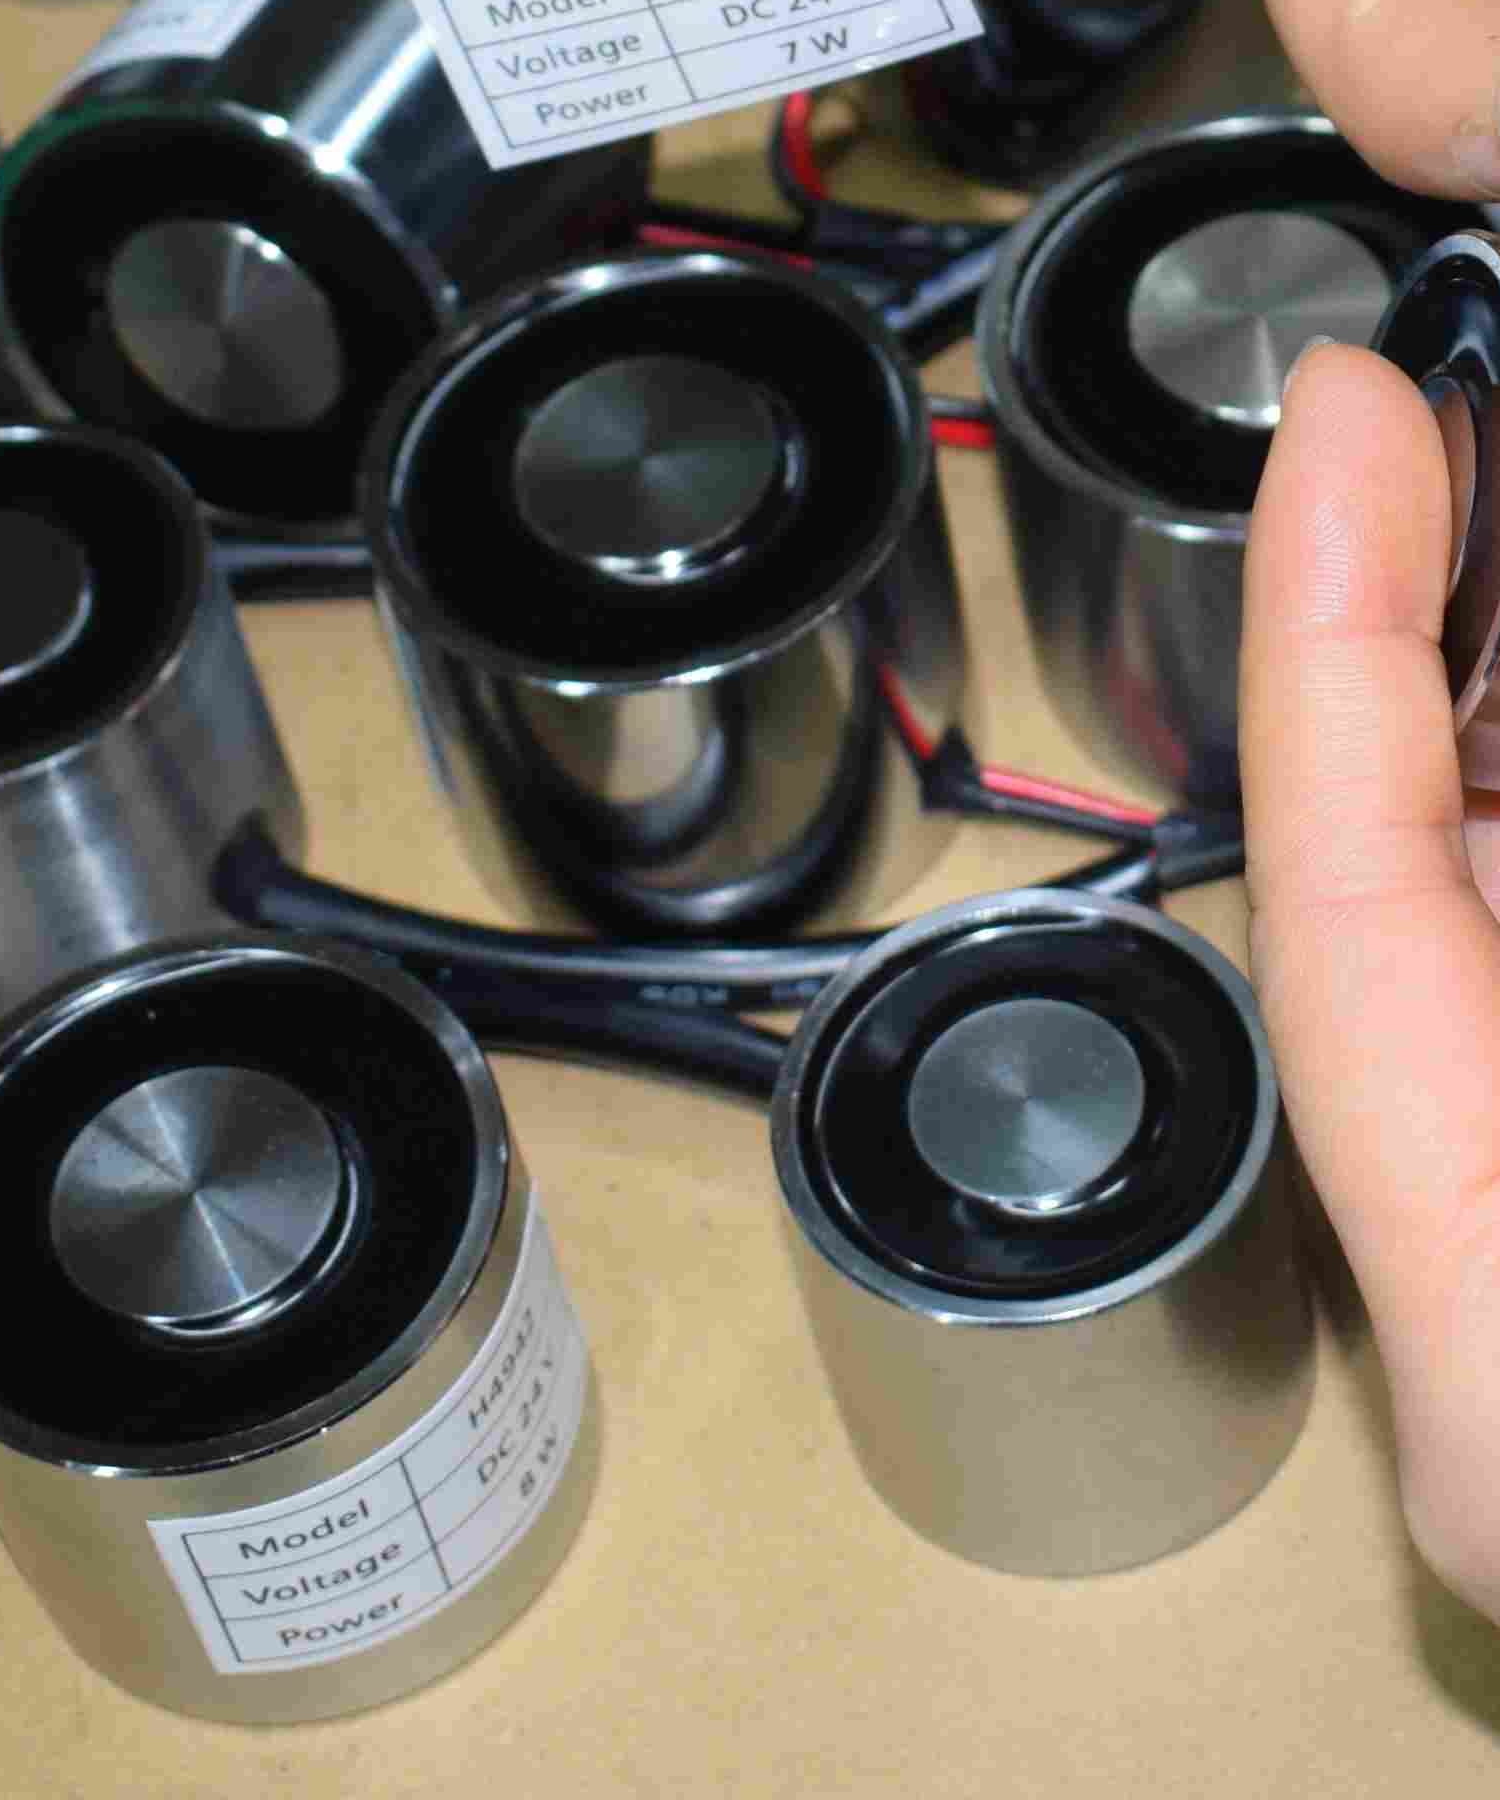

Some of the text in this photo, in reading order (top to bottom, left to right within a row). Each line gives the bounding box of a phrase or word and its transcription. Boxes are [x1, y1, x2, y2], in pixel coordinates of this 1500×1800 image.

[495, 28, 642, 81] Voltage
[536, 28, 850, 125] Power 7 W
[239, 1499, 370, 1559] Model
[243, 1543, 404, 1606] Voltage
[477, 1429, 512, 1484] DC
[522, 1382, 542, 1428] 24
[279, 1594, 405, 1648] Power
[521, 1470, 535, 1497] 8
